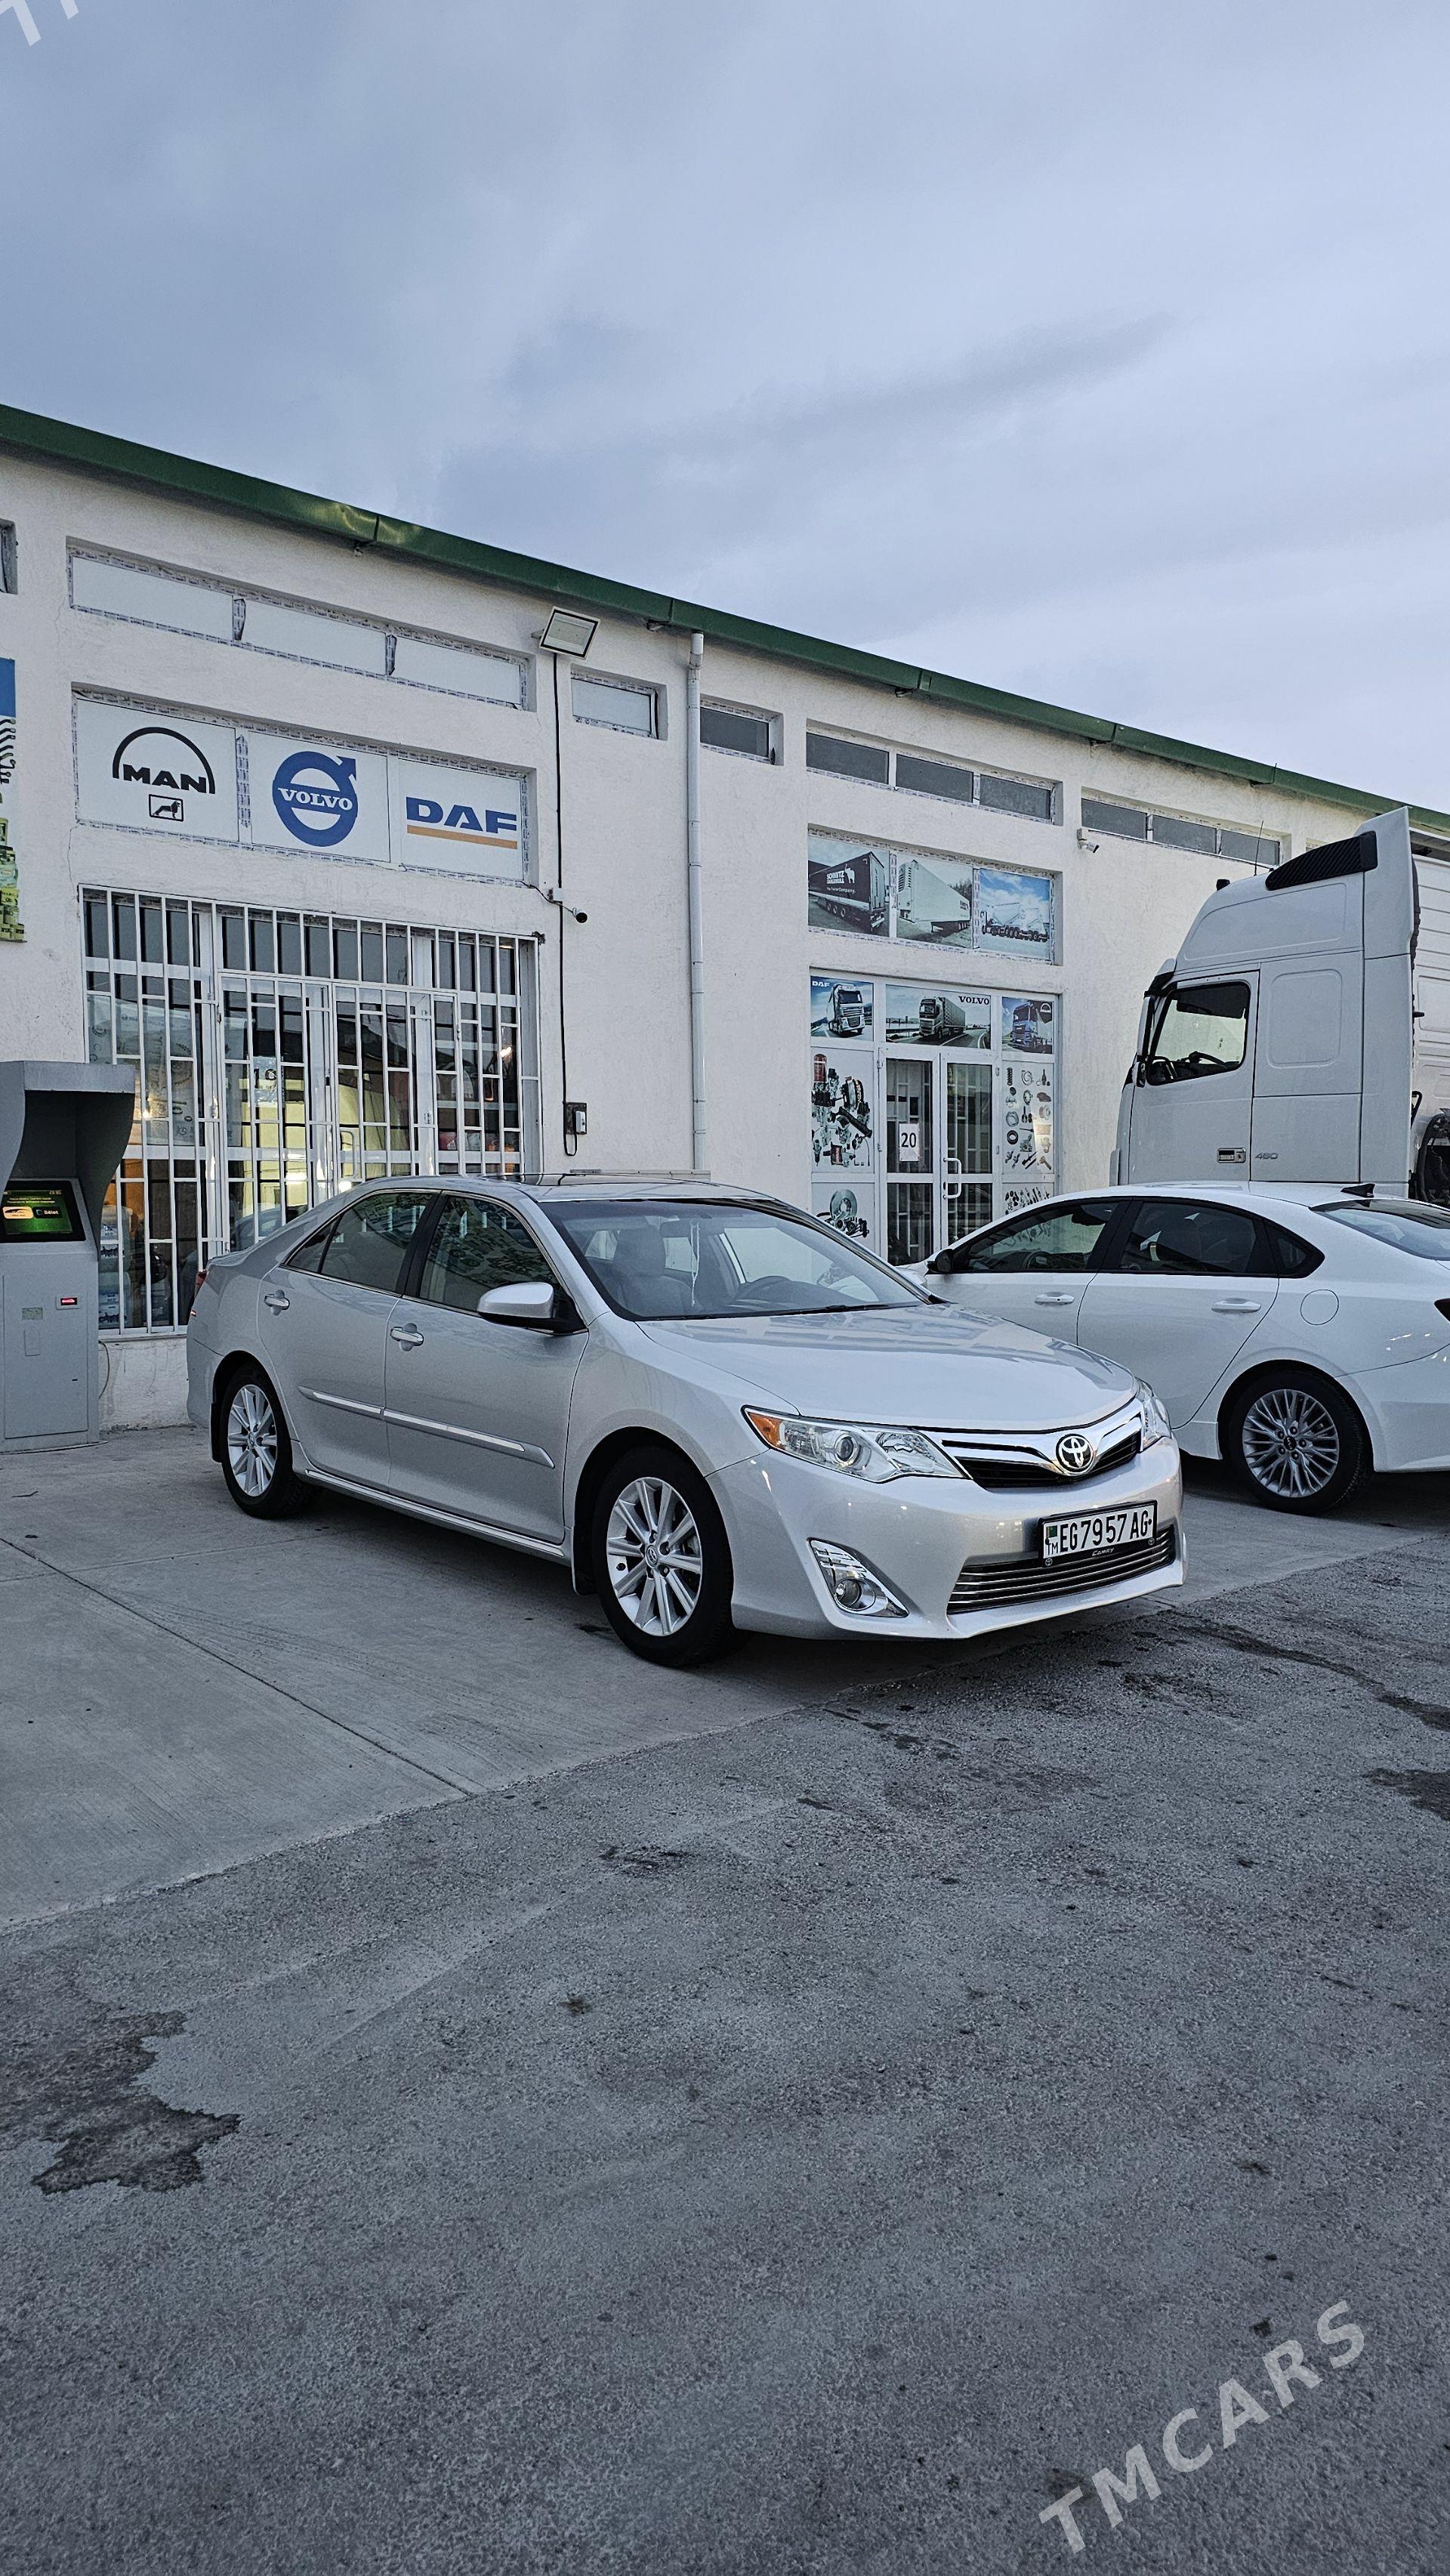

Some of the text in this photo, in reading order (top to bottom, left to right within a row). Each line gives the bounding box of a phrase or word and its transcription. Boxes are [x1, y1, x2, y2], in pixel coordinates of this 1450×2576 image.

[123, 764, 206, 793] MAN
[278, 788, 353, 811] VOLVO
[406, 796, 517, 833] DAF
[958, 996, 989, 1005] VOLVO
[901, 1132, 916, 1147] 20
[1047, 1542, 1058, 1555] TM
